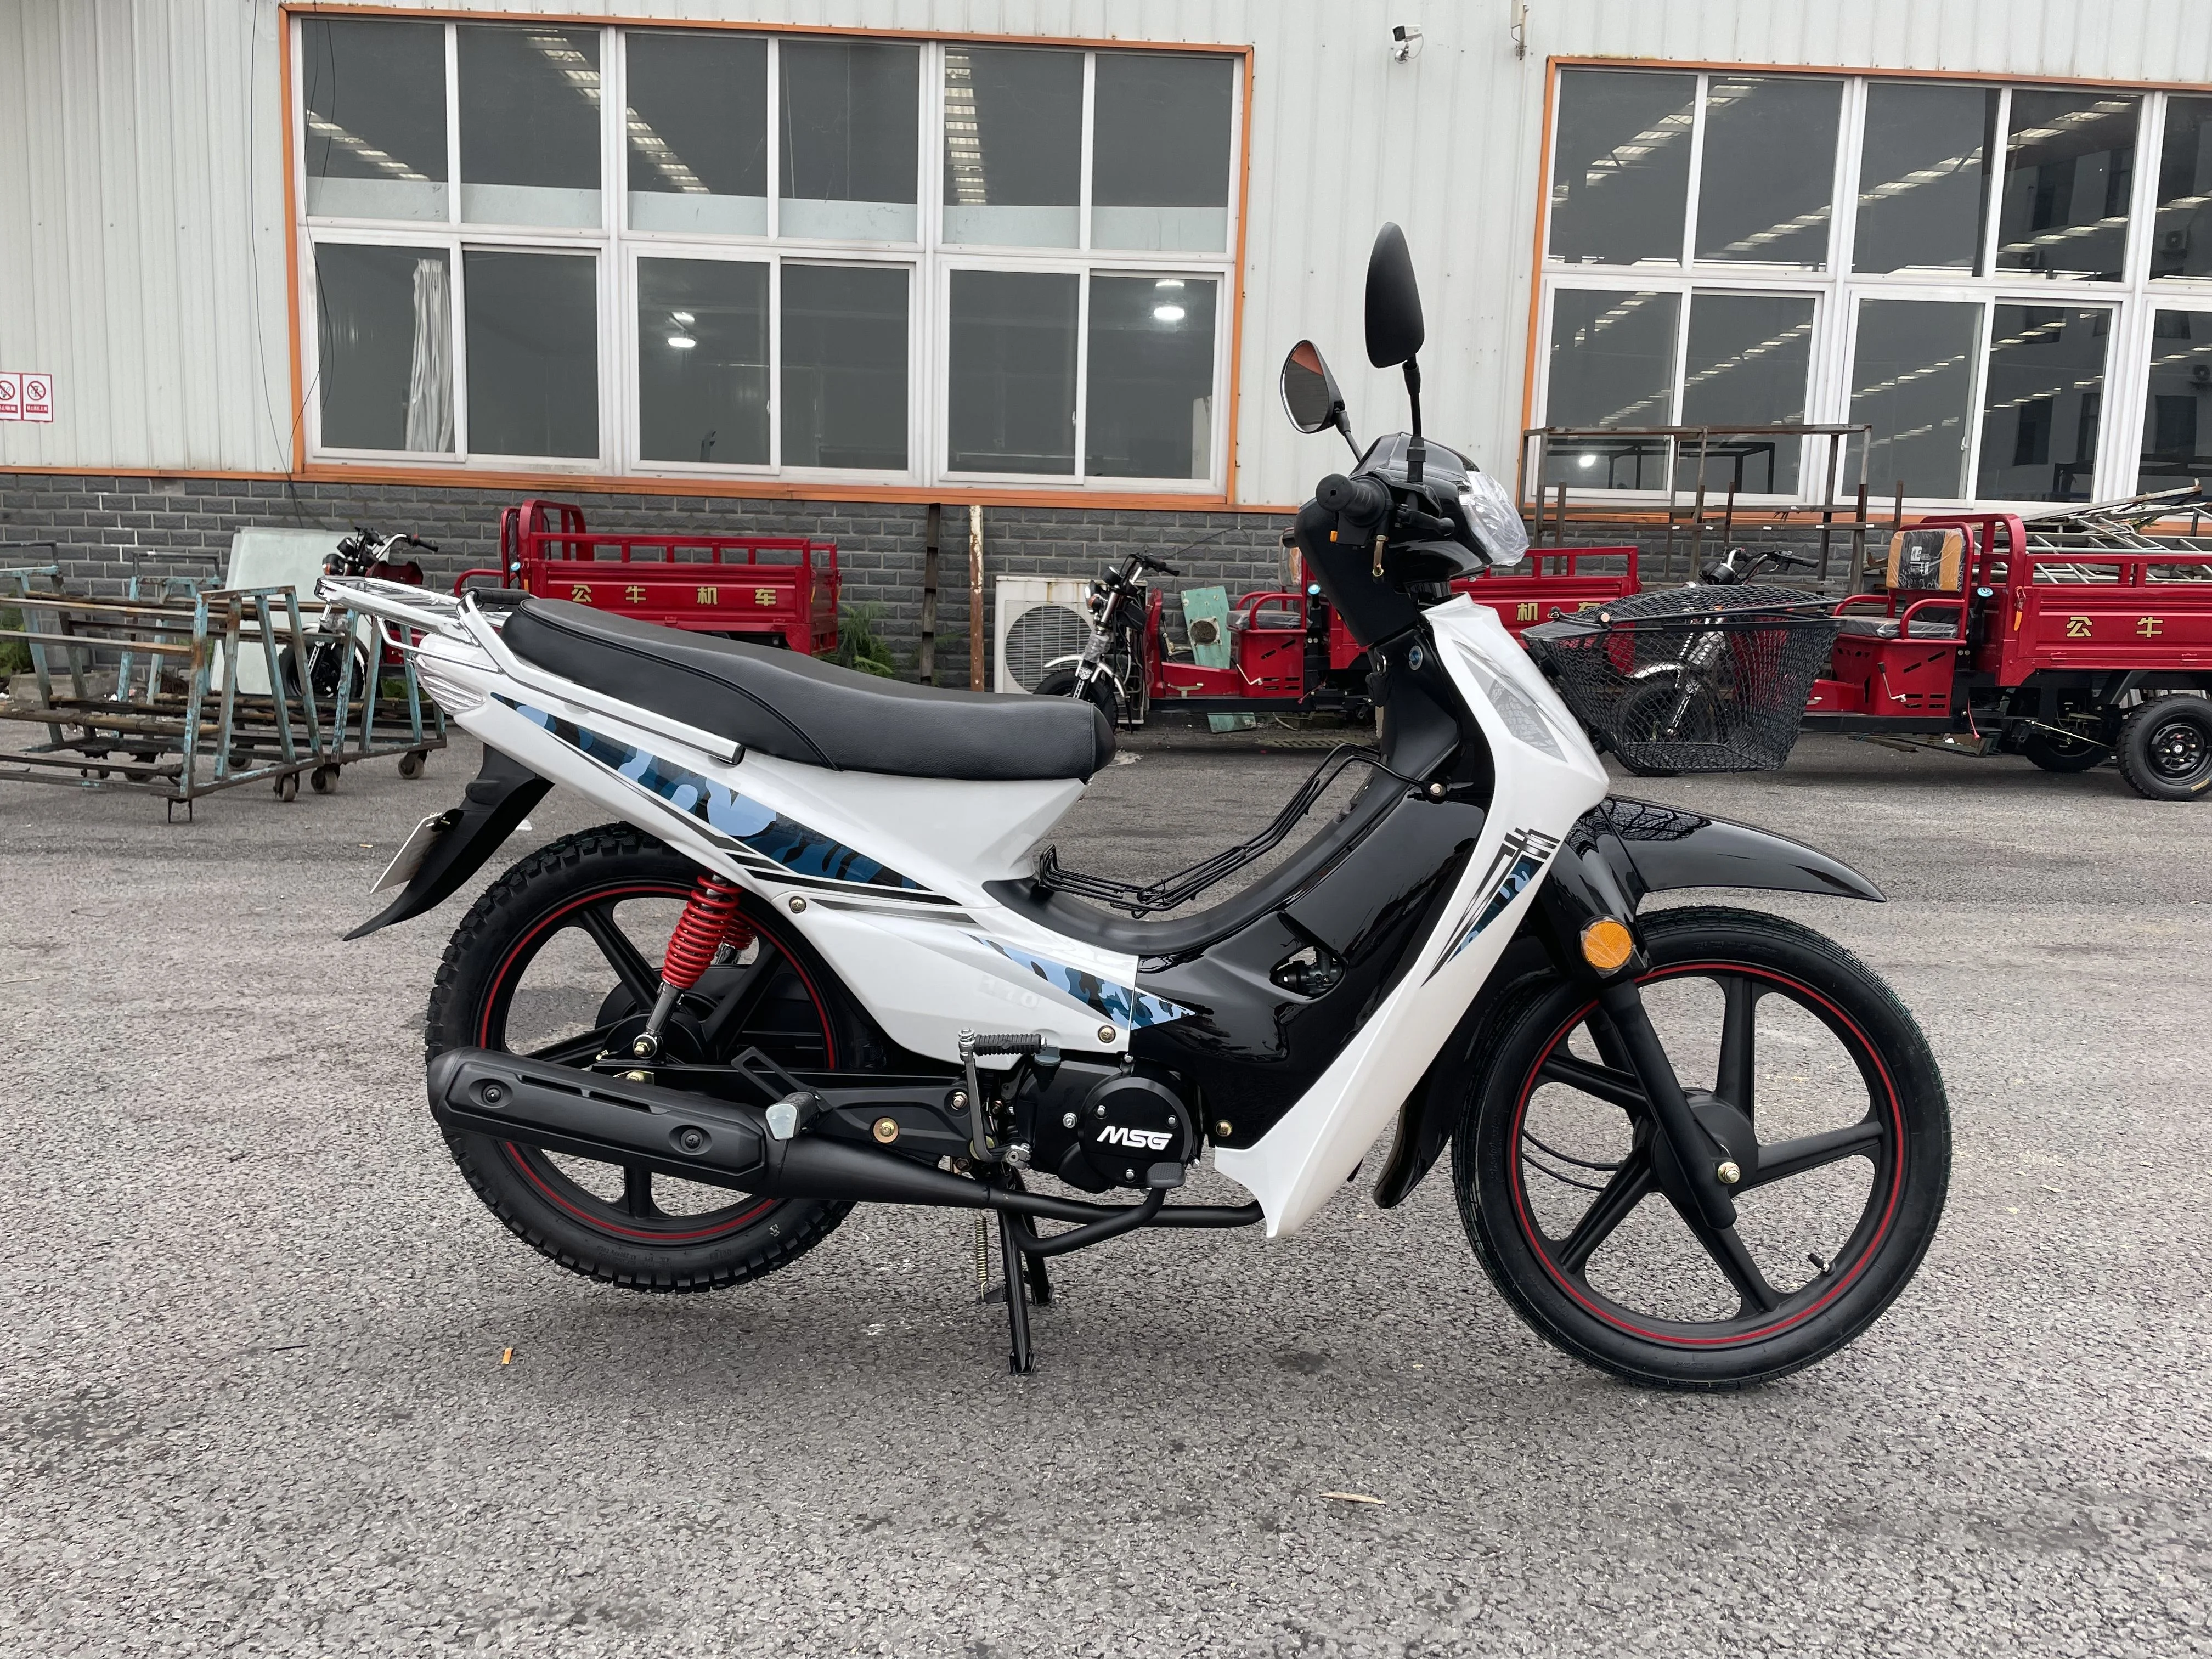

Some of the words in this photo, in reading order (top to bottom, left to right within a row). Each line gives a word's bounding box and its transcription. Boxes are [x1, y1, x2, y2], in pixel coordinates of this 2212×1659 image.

[571, 584, 777, 607] 公牛机车
[2066, 616, 2164, 638] 公牛
[1096, 1125, 1173, 1151] MSG
